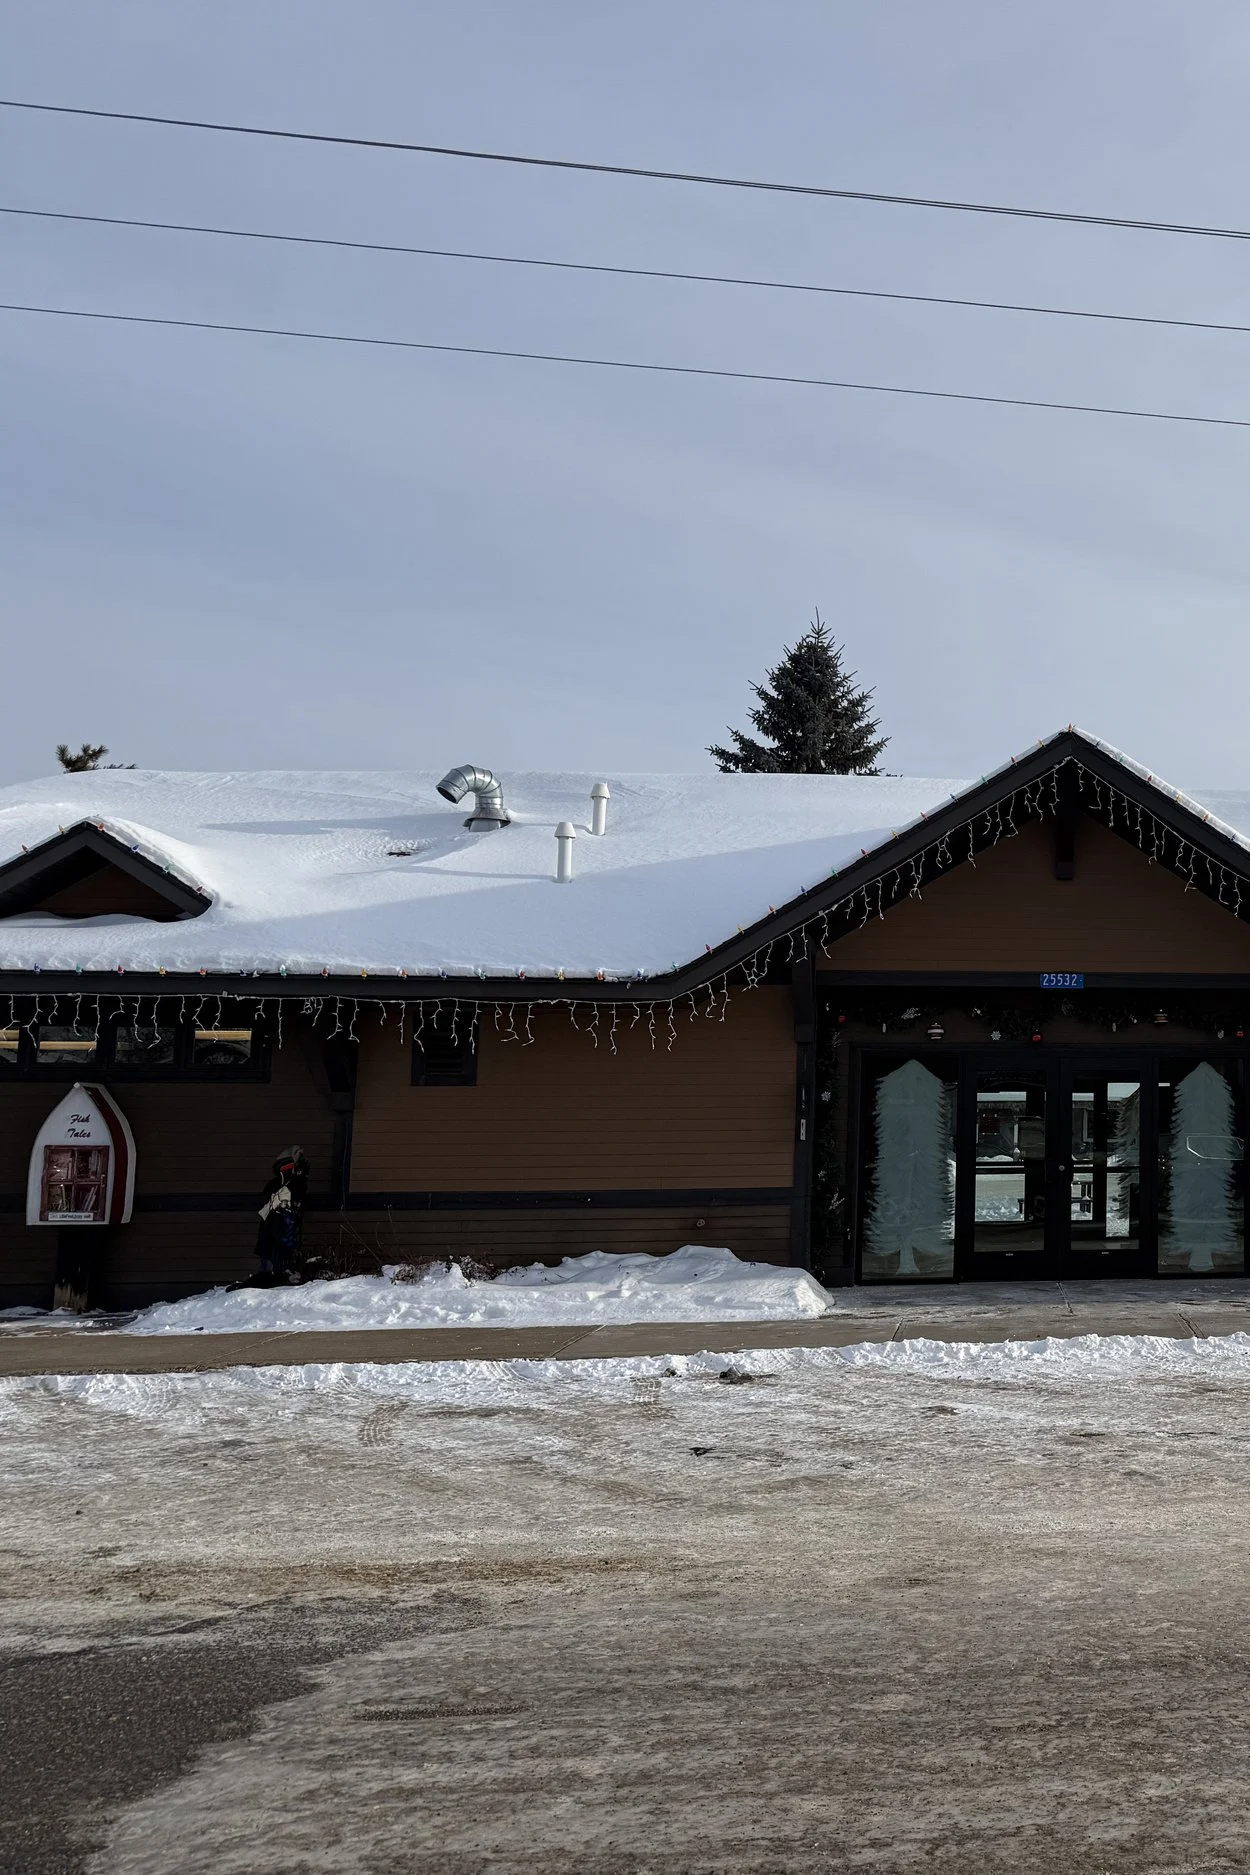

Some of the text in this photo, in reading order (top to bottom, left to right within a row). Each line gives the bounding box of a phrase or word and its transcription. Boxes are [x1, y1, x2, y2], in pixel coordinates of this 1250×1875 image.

[1043, 973, 1077, 986] 25532
[70, 1114, 91, 1124] Fish
[67, 1128, 91, 1138] Tales
